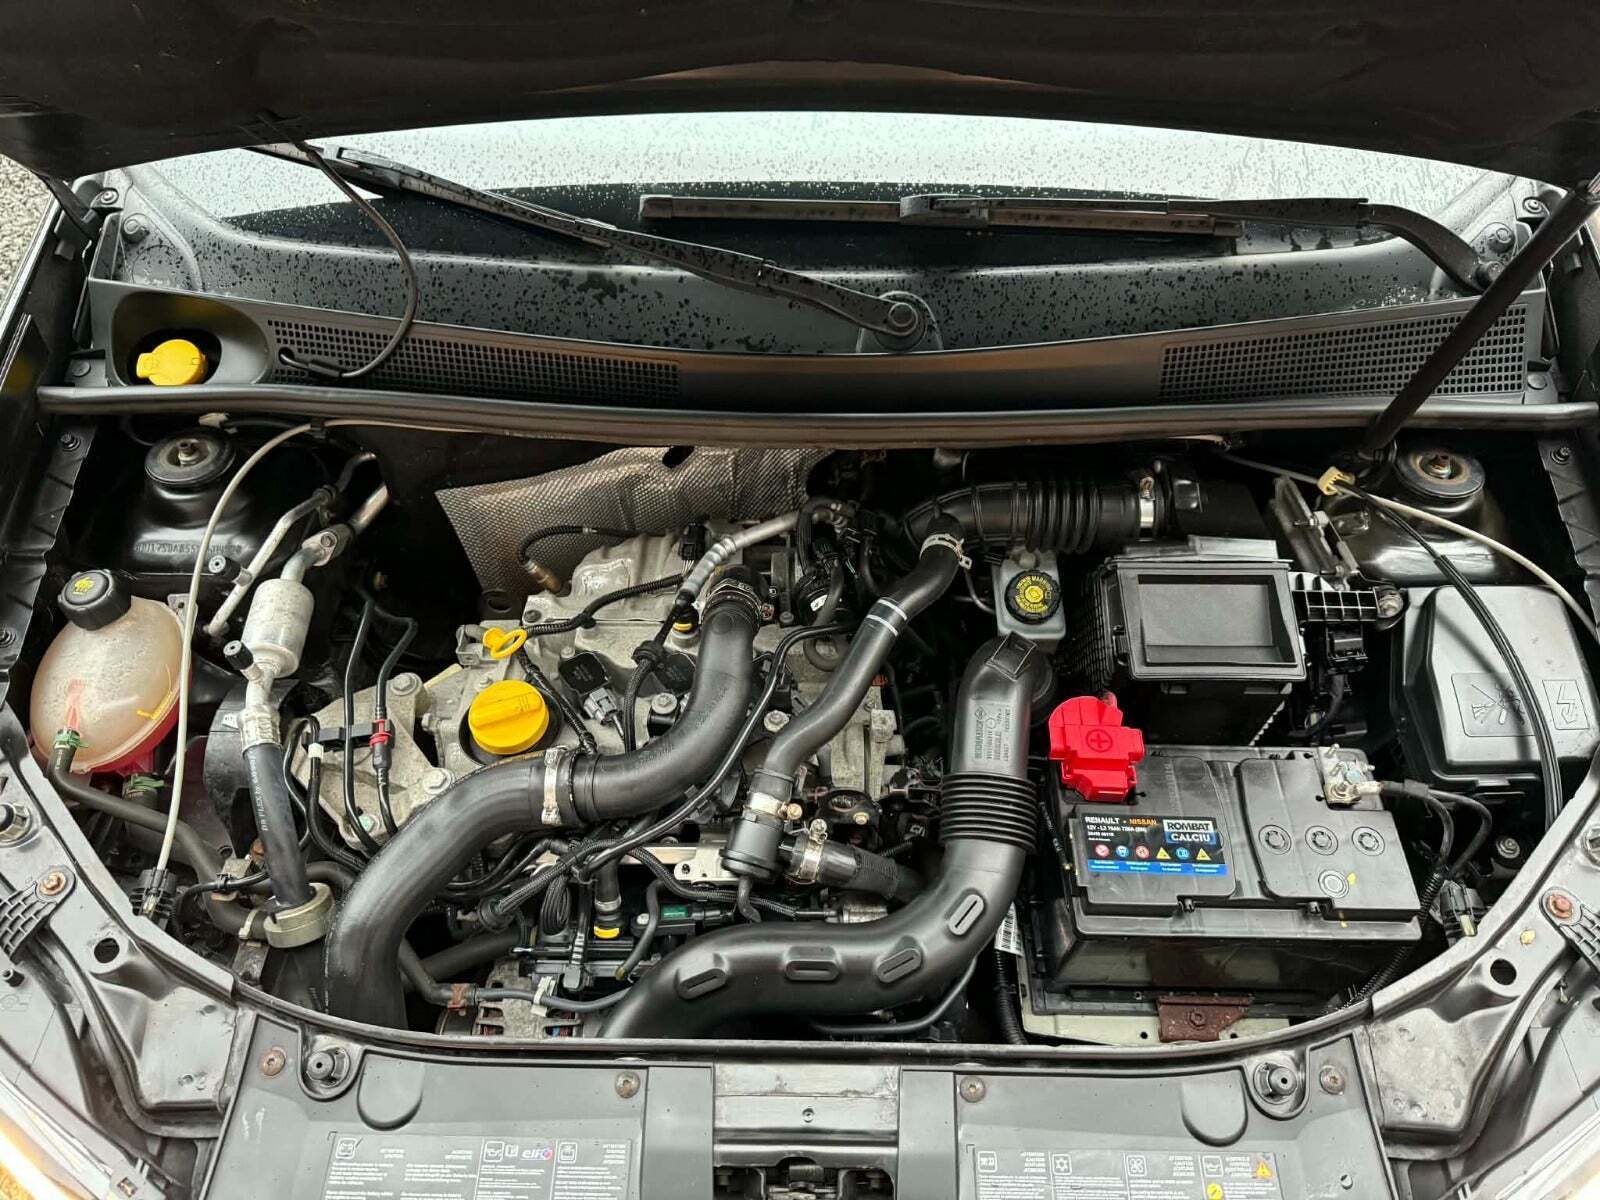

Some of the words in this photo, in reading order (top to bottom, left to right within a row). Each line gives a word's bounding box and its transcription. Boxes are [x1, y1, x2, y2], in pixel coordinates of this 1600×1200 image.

[1085, 816, 1120, 825] RENAULT
[1129, 818, 1158, 826] NISSAN
[1167, 821, 1211, 832] ROMBAT
[1170, 833, 1212, 843] CALCIU
[521, 1148, 545, 1160] elf
